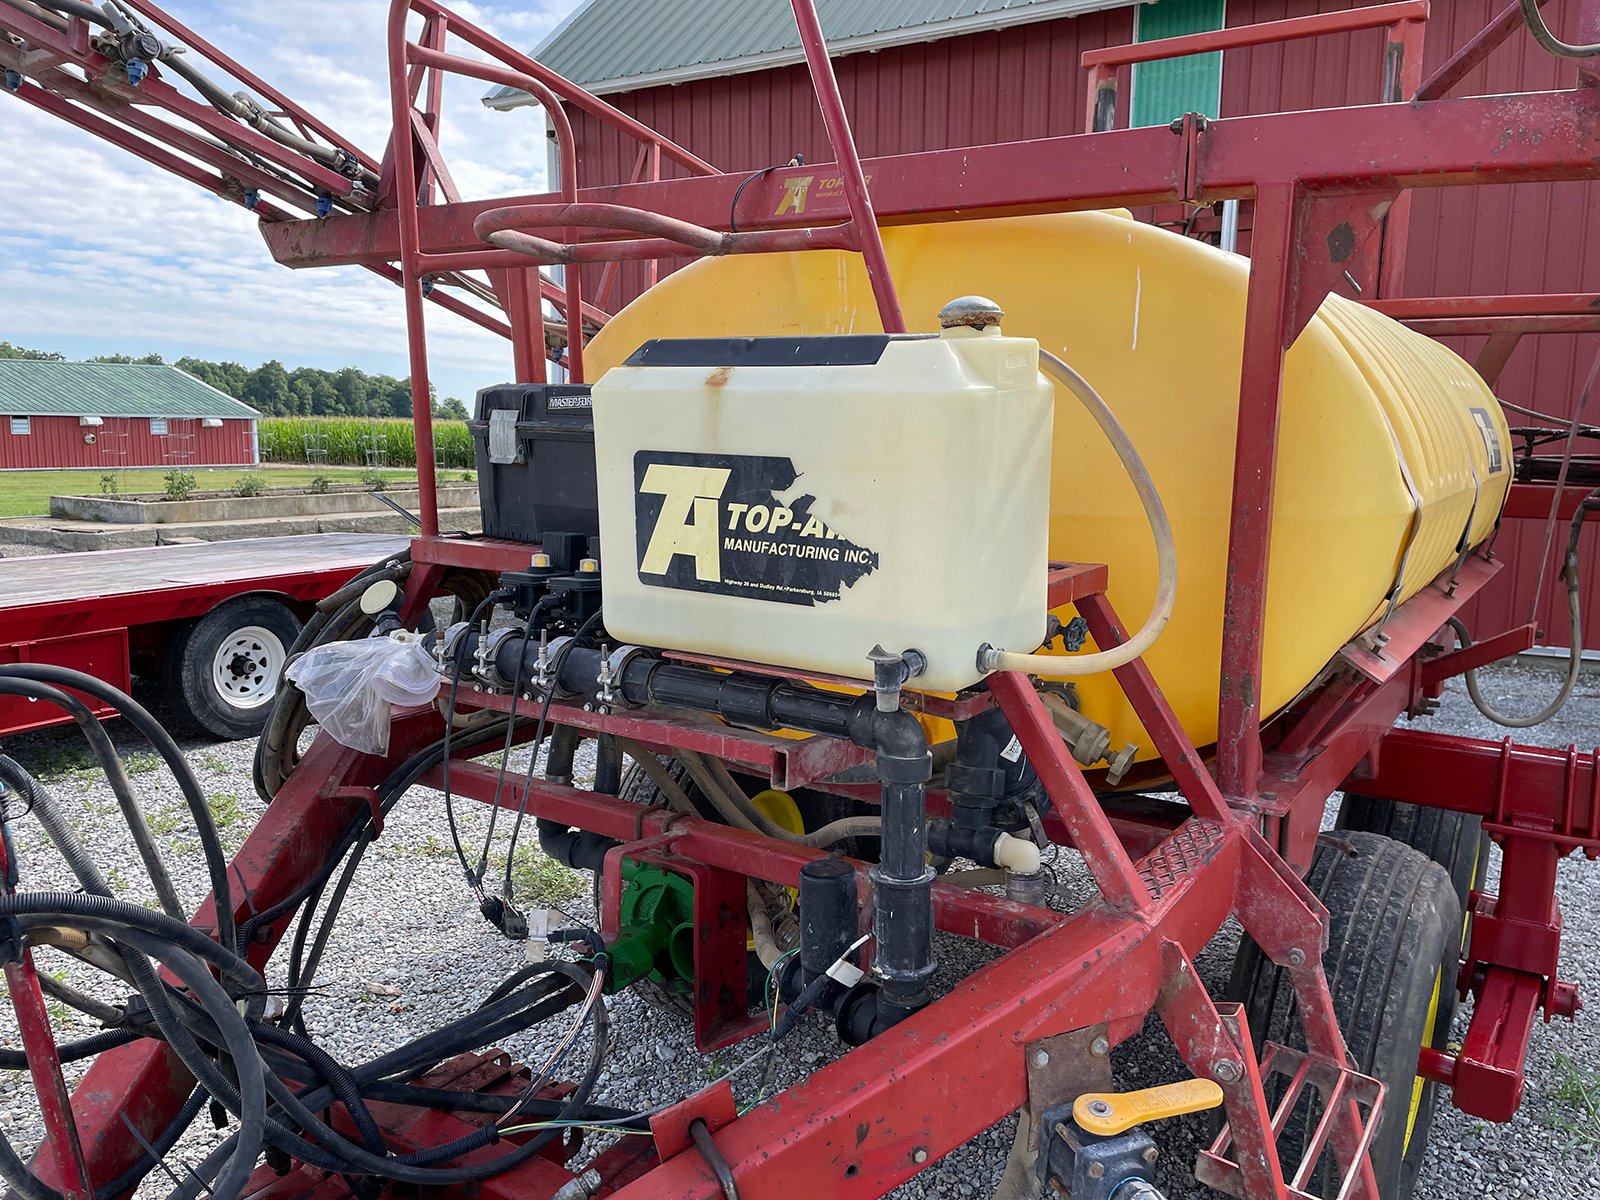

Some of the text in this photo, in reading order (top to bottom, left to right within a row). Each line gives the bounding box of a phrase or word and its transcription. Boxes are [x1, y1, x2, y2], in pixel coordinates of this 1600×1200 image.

[549, 397, 593, 407] MASTERFOR
[639, 463, 732, 583] TA
[727, 503, 847, 541] TOP-A
[723, 537, 873, 565] MANUFACTURING INC.
[724, 578, 743, 587] Highway
